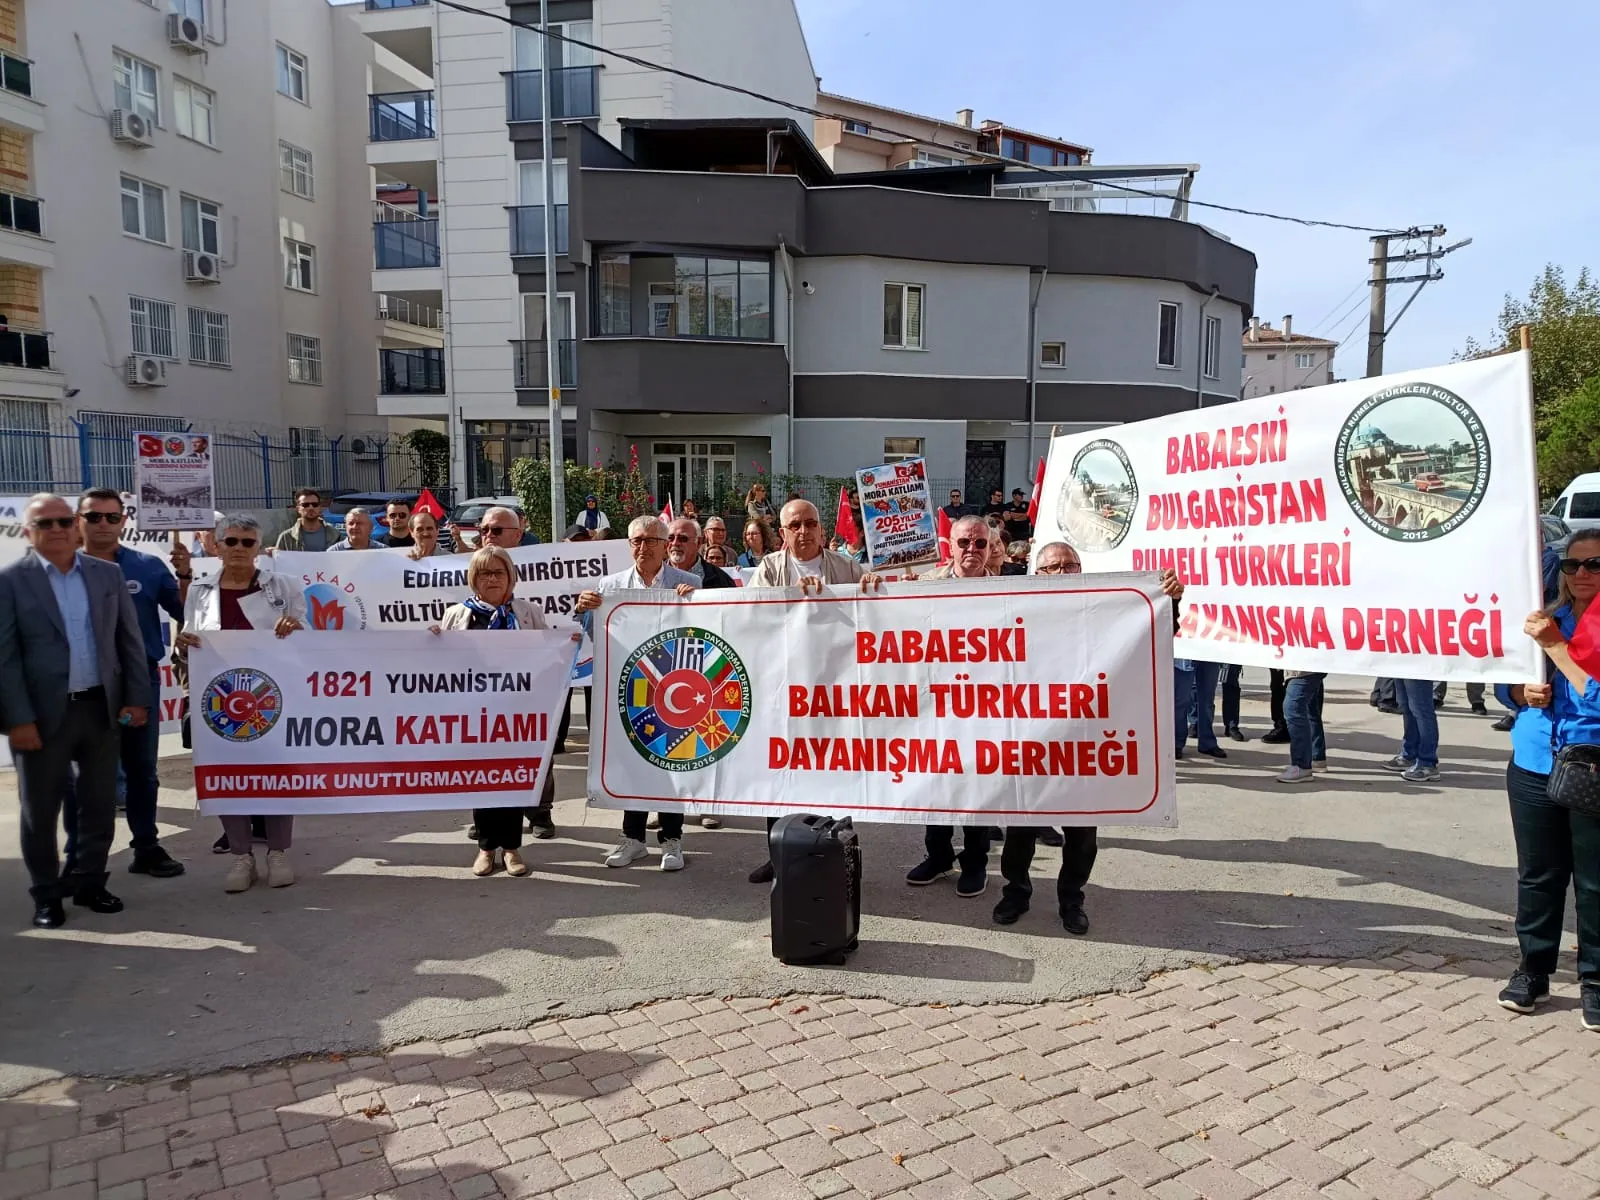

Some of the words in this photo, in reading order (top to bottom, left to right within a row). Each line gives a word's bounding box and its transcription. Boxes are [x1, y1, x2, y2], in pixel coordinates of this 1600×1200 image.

[1379, 386, 1431, 400] TÜRKLERİ
[1432, 388, 1470, 418] KÜLTÜR
[1348, 396, 1379, 428] RUMELİ
[1468, 417, 1480, 431] VE
[1166, 405, 1288, 475] BABAESKİ
[1336, 429, 1353, 496] BULGARİSTAN
[1474, 431, 1488, 495] DAYANIŞMA
[864, 489, 887, 501] MORA
[888, 482, 925, 497] KATLİAMI
[1146, 473, 1326, 531] BULGARİSTAN
[875, 514, 900, 531] 205
[900, 512, 922, 524] YILLIK
[890, 523, 909, 534] ACI
[1351, 500, 1390, 534] BABAESKİ
[1440, 496, 1477, 533] DERNEĞİ
[1402, 531, 1429, 540] 2012
[403, 568, 468, 590] EDİRN
[514, 553, 609, 582] NIRÖTESİ
[1215, 527, 1351, 586] TÜRKLERİ
[303, 572, 355, 593] SKAD
[856, 617, 1027, 664] BABAESKİ
[1174, 603, 1335, 659] AYANIŞMA
[1343, 593, 1504, 658] DERNEĞİ
[306, 671, 372, 697] 1821
[386, 668, 531, 693] YUNANİSTAN
[618, 665, 631, 713] BALKAN
[629, 629, 678, 666] TÜRKLERİ
[704, 632, 743, 673] DAYANIŞMA
[738, 673, 750, 718] DERNEĞİ
[789, 684, 919, 718] BALKAN
[929, 672, 1110, 719] TÜRKLERİ
[285, 716, 384, 747] MORA
[395, 707, 547, 745] KATLİAMI
[648, 754, 690, 771] BABAESKİ
[693, 755, 716, 770] 2016
[768, 736, 964, 783] DAYANIŞMA
[975, 729, 1138, 777] DERNEĞİ
[205, 774, 327, 791] UNUTMADIK
